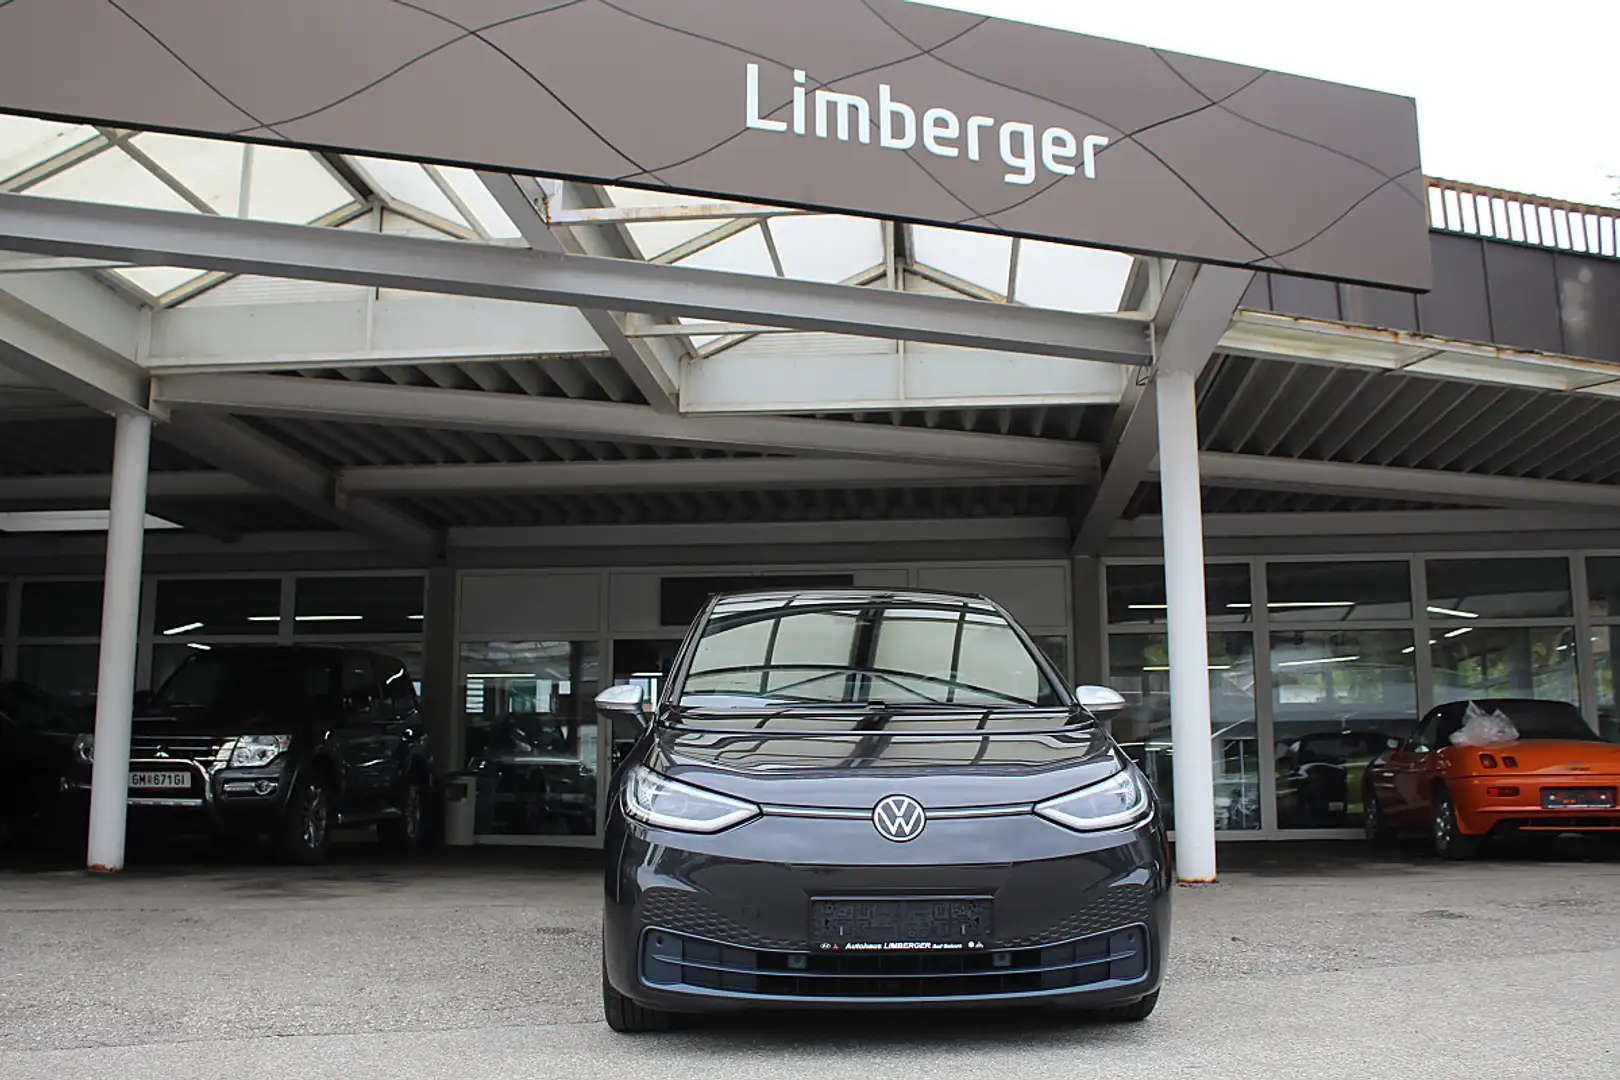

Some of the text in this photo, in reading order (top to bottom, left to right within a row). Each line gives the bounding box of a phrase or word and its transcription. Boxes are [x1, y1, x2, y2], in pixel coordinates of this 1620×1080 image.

[746, 63, 1109, 185] Limberger
[875, 796, 924, 839] VW
[845, 942, 882, 950] Autohaus
